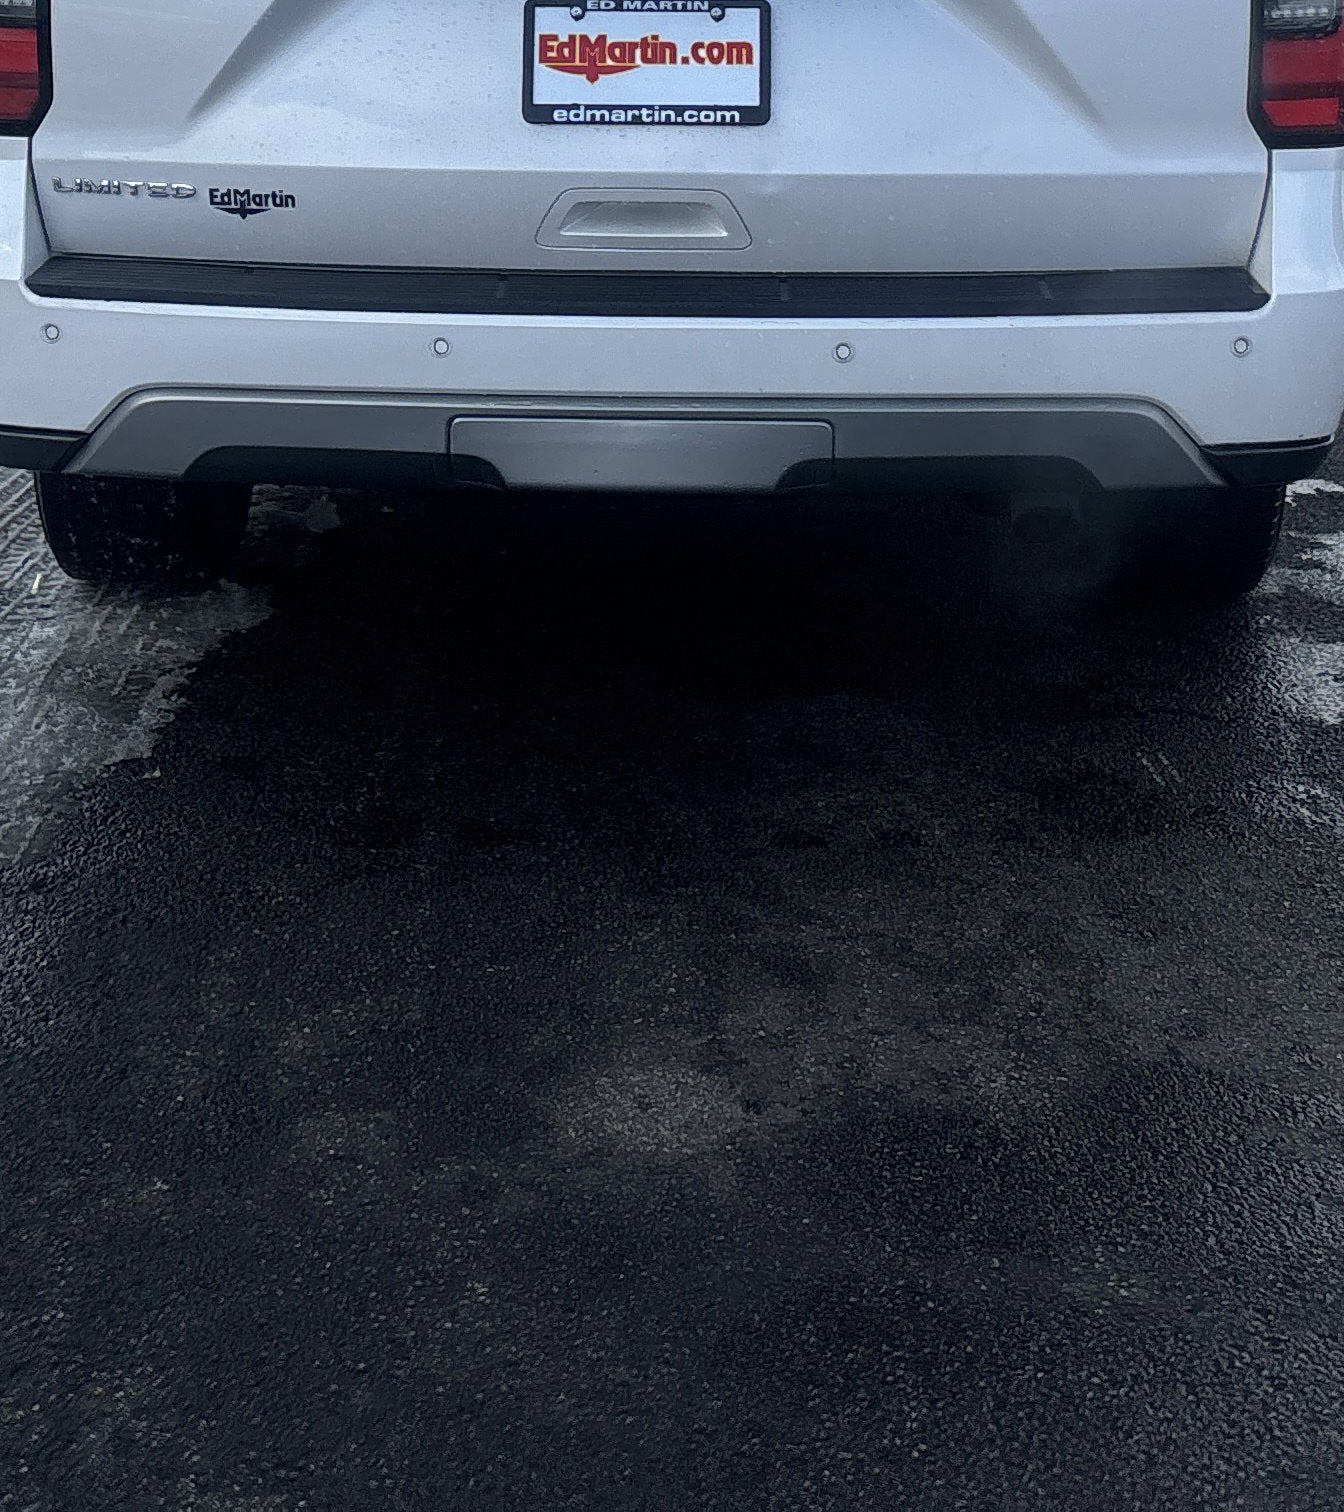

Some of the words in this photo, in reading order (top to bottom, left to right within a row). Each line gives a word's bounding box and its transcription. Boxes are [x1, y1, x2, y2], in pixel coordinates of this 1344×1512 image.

[586, 0, 616, 11] ED
[622, 0, 709, 11] MARTIN
[553, 106, 741, 124] edmartin.com
[51, 176, 197, 199] LIMITED
